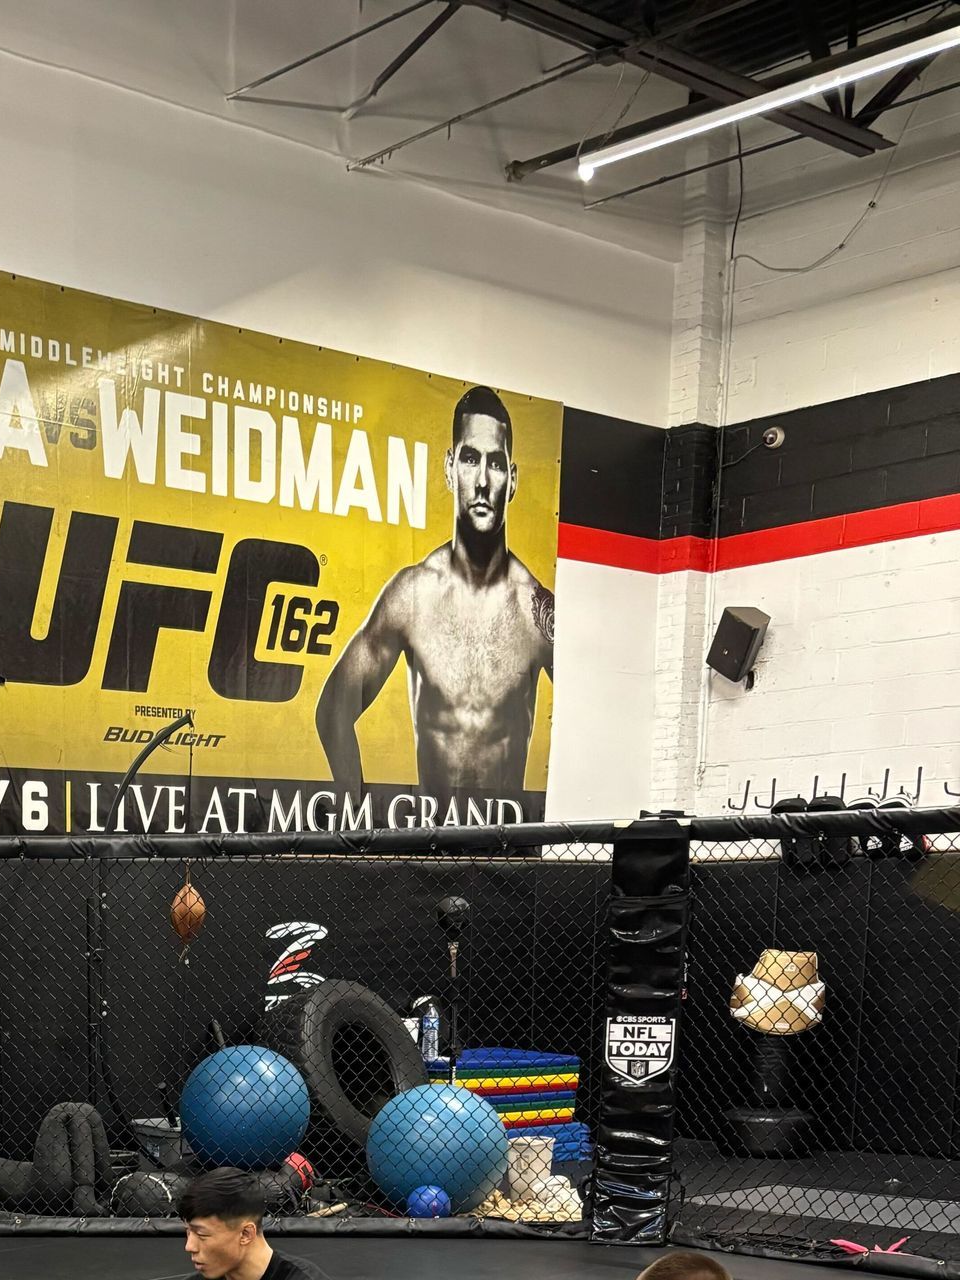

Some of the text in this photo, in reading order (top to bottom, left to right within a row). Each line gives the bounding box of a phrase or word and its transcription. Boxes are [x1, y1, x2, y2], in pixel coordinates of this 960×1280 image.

[0, 328, 185, 388] MIDDLEWEIGHT
[202, 372, 364, 424] CHAMPIONSHIP
[99, 377, 429, 530] WEIDMAN
[265, 593, 340, 656] 162
[134, 705, 184, 719] PRESENTED
[103, 726, 227, 748] BUD LIGHT
[21, 780, 49, 831] 6
[86, 782, 525, 834] LIVE AT MGM GRAND
[622, 1015, 667, 1023] CBS SPORTS
[623, 1026, 657, 1039] NFL
[609, 1041, 671, 1056] TODAY
